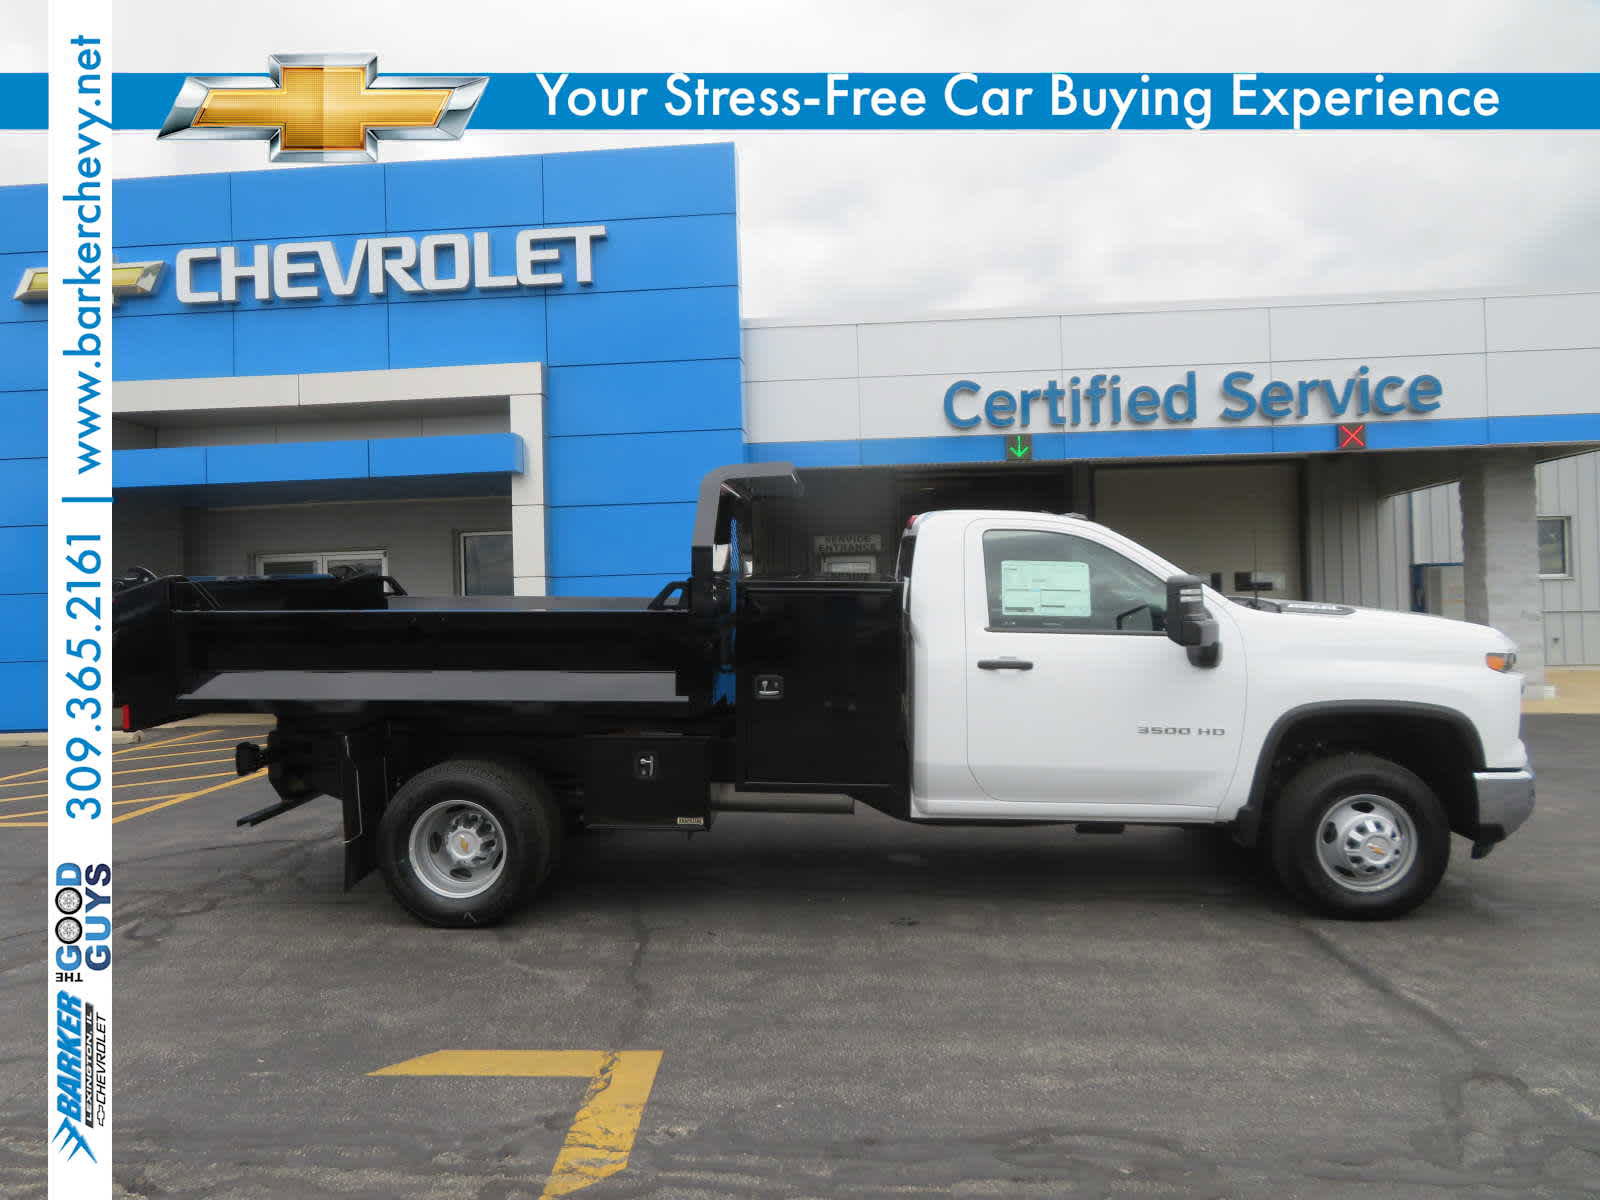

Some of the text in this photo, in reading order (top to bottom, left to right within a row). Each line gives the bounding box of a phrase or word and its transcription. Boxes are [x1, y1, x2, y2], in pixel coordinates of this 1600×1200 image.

[176, 225, 607, 304] CHEVROLET
[943, 366, 1444, 430] Certified Service
[1136, 726, 1225, 736] 3500 HD
